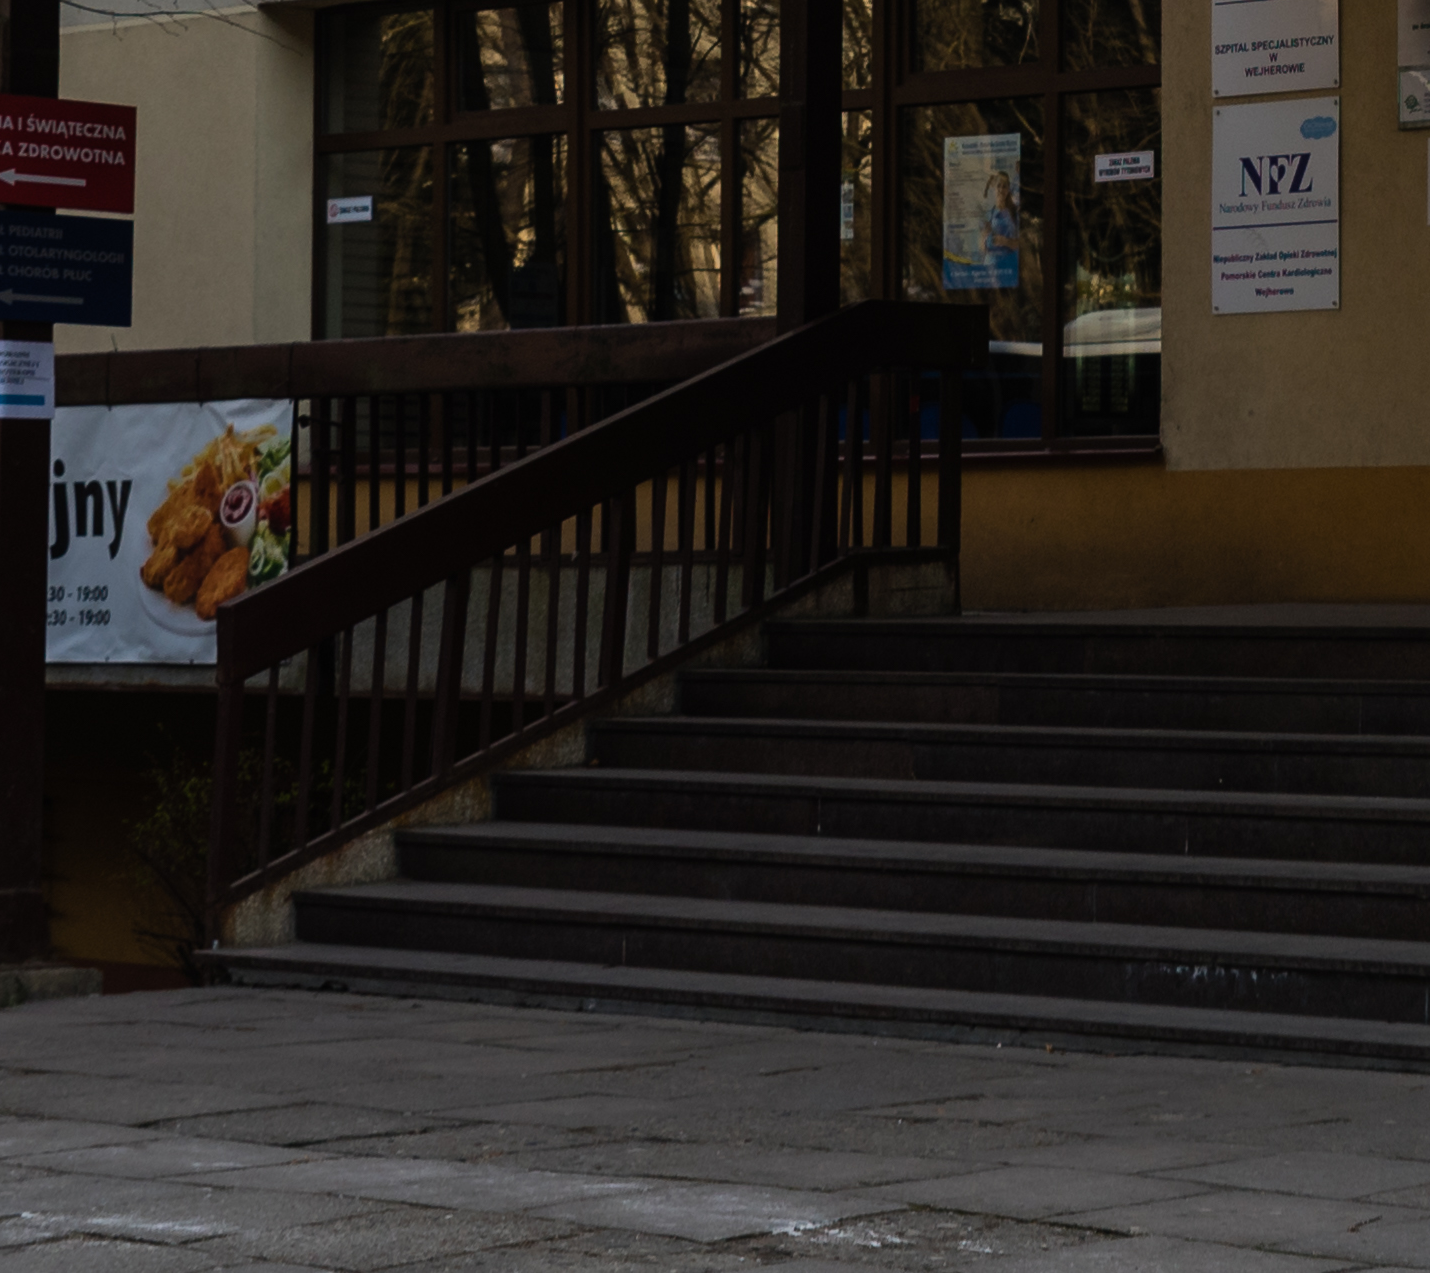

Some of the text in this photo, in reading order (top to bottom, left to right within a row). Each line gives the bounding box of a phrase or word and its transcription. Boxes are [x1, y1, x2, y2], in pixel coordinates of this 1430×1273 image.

[1214, 34, 1335, 55] SZPITAL SPECJALISTYCZNY
[1269, 52, 1278, 63] W
[1244, 62, 1305, 78] WEJHEROWIE
[26, 113, 127, 141] ŚWIĄTECZNA
[17, 142, 126, 166] ZDROWOTNA
[1239, 152, 1313, 197] NFZ
[1219, 196, 1332, 214] Narodowy Fundusz Zdrowia
[8, 225, 64, 240] PEDIATRII
[8, 245, 125, 264] OTOLARYNGOLOGII
[7, 264, 60, 280] CHORÓB
[62, 269, 93, 282] PŁUC
[1221, 270, 1256, 281] Pomorskie
[77, 585, 109, 602] 19:00
[79, 609, 111, 626] 19:00
